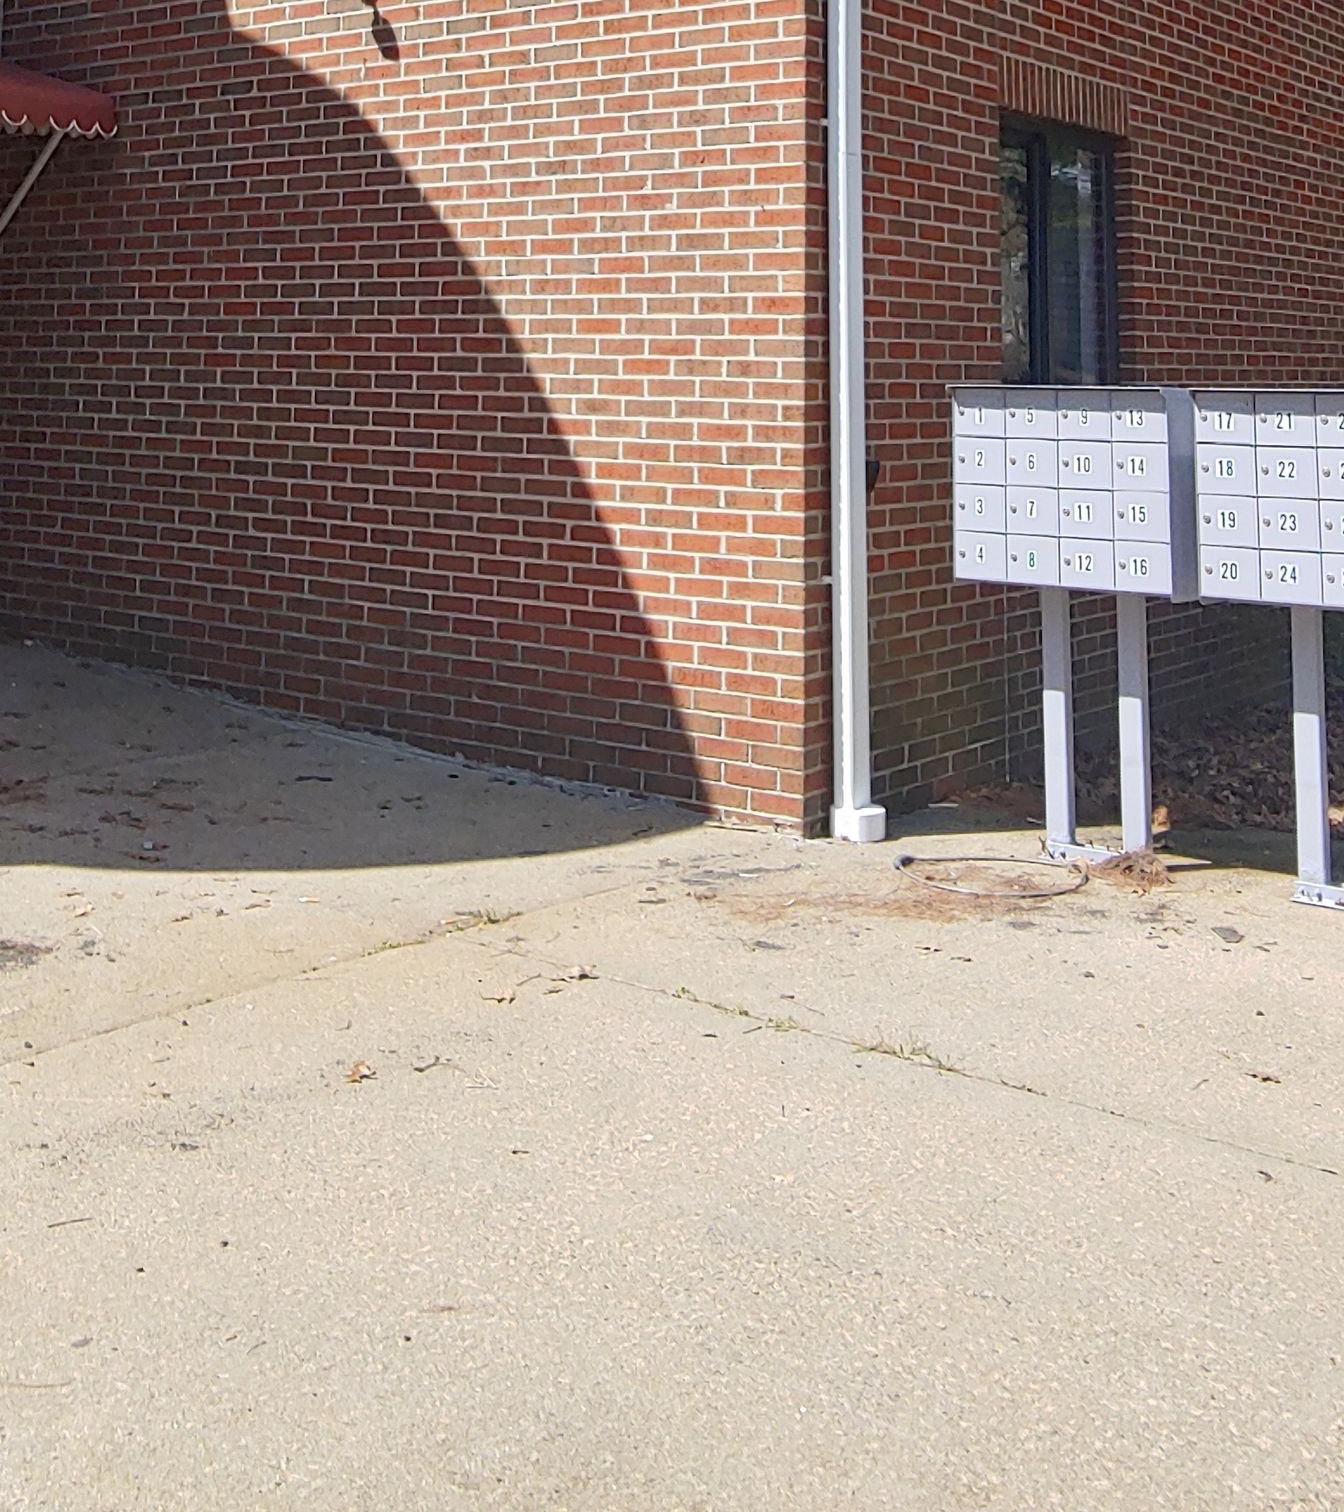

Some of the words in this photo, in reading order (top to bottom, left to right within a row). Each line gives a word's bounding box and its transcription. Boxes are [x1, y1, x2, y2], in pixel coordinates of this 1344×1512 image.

[978, 406, 984, 424] 1
[1026, 406, 1034, 424] 5
[1080, 408, 1089, 425] 9
[1128, 409, 1144, 426] 13
[1217, 412, 1233, 430] 17
[1275, 411, 1293, 430] 21
[976, 451, 983, 467] 2
[1028, 454, 1035, 470] 6
[1076, 456, 1091, 473] 10
[1130, 458, 1144, 475] 14
[1218, 460, 1234, 477] 18
[1278, 461, 1295, 479] 22
[976, 498, 983, 514] 3
[1028, 500, 1035, 517] 7
[1077, 504, 1091, 521] 11
[1131, 506, 1146, 523] 15
[1220, 511, 1236, 529] 19
[1280, 513, 1297, 532] 23
[977, 546, 984, 562] 4
[1028, 551, 1035, 568] 8
[1078, 555, 1092, 572] 12
[1133, 558, 1148, 576] 16
[1221, 562, 1238, 580] 20
[1280, 565, 1297, 583] 24
